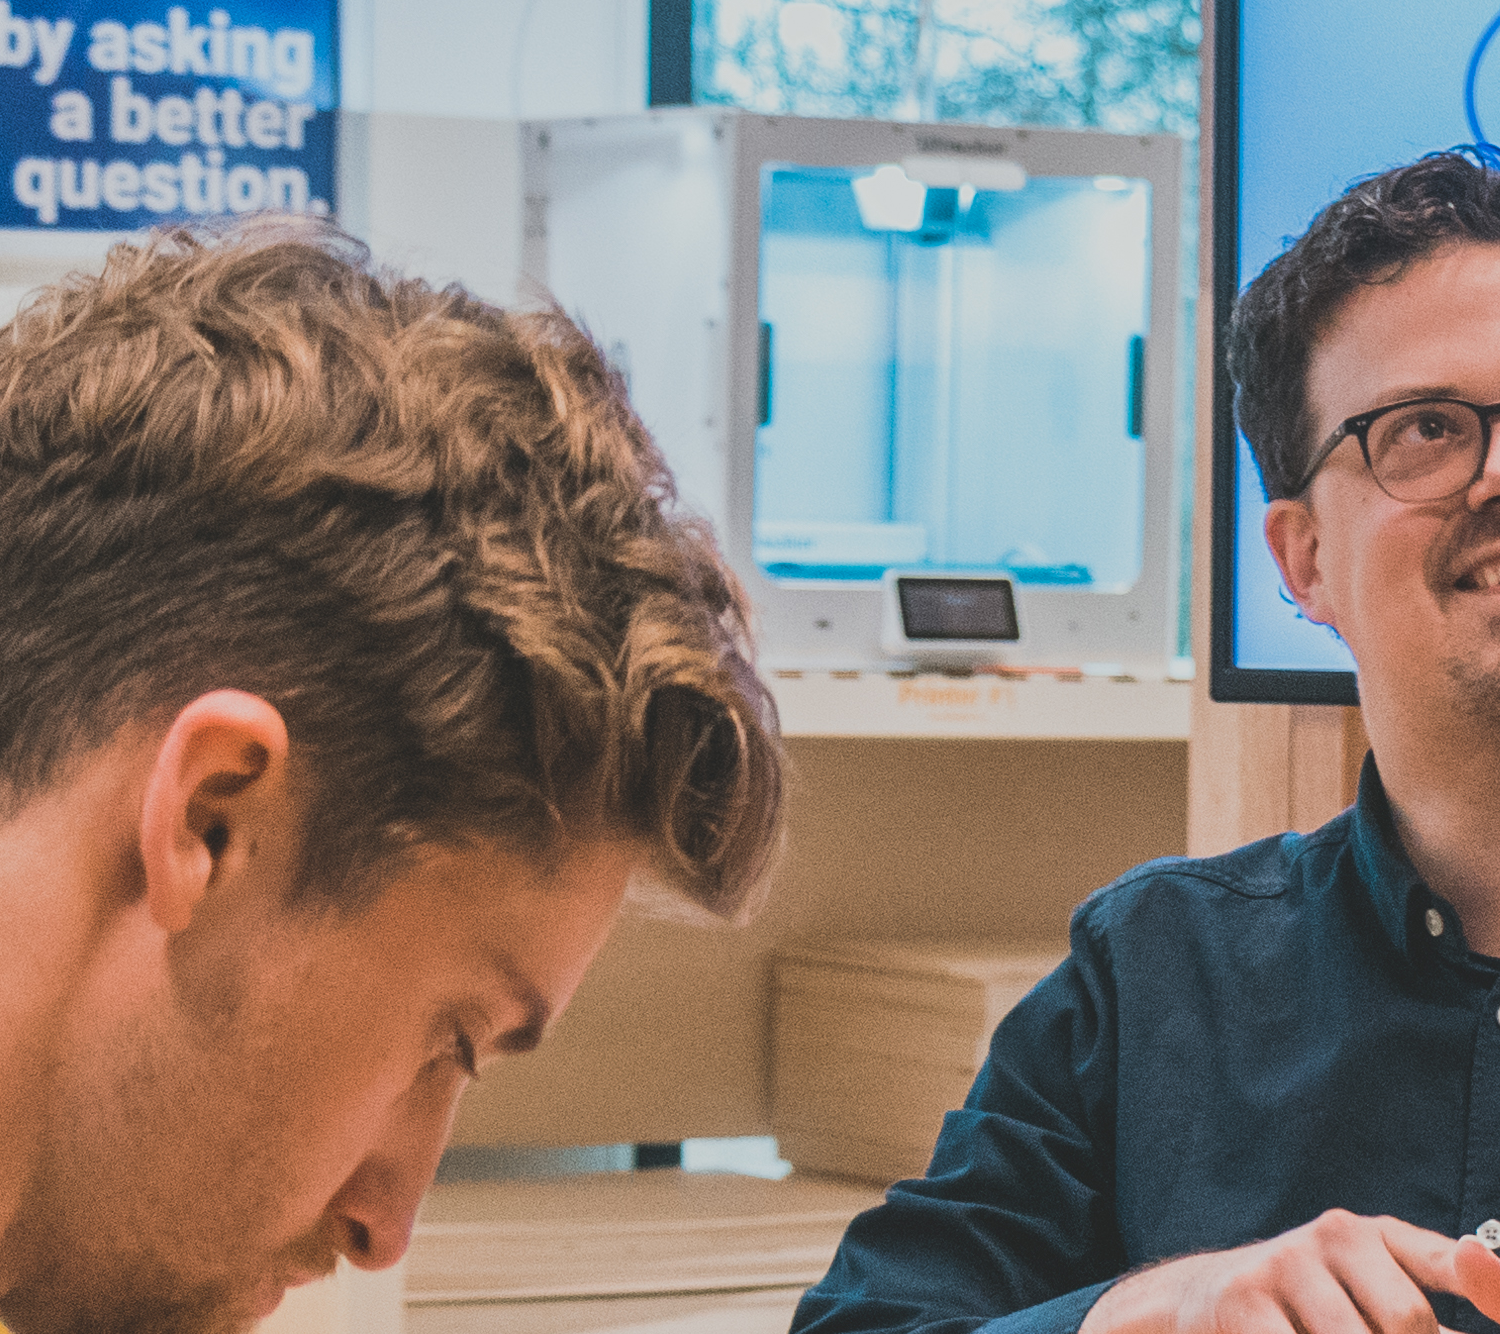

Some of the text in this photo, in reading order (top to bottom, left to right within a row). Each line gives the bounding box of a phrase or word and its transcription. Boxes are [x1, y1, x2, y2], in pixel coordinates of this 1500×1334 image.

[88, 6, 314, 98] asking
[50, 77, 316, 149] a better
[13, 150, 330, 224] question.
